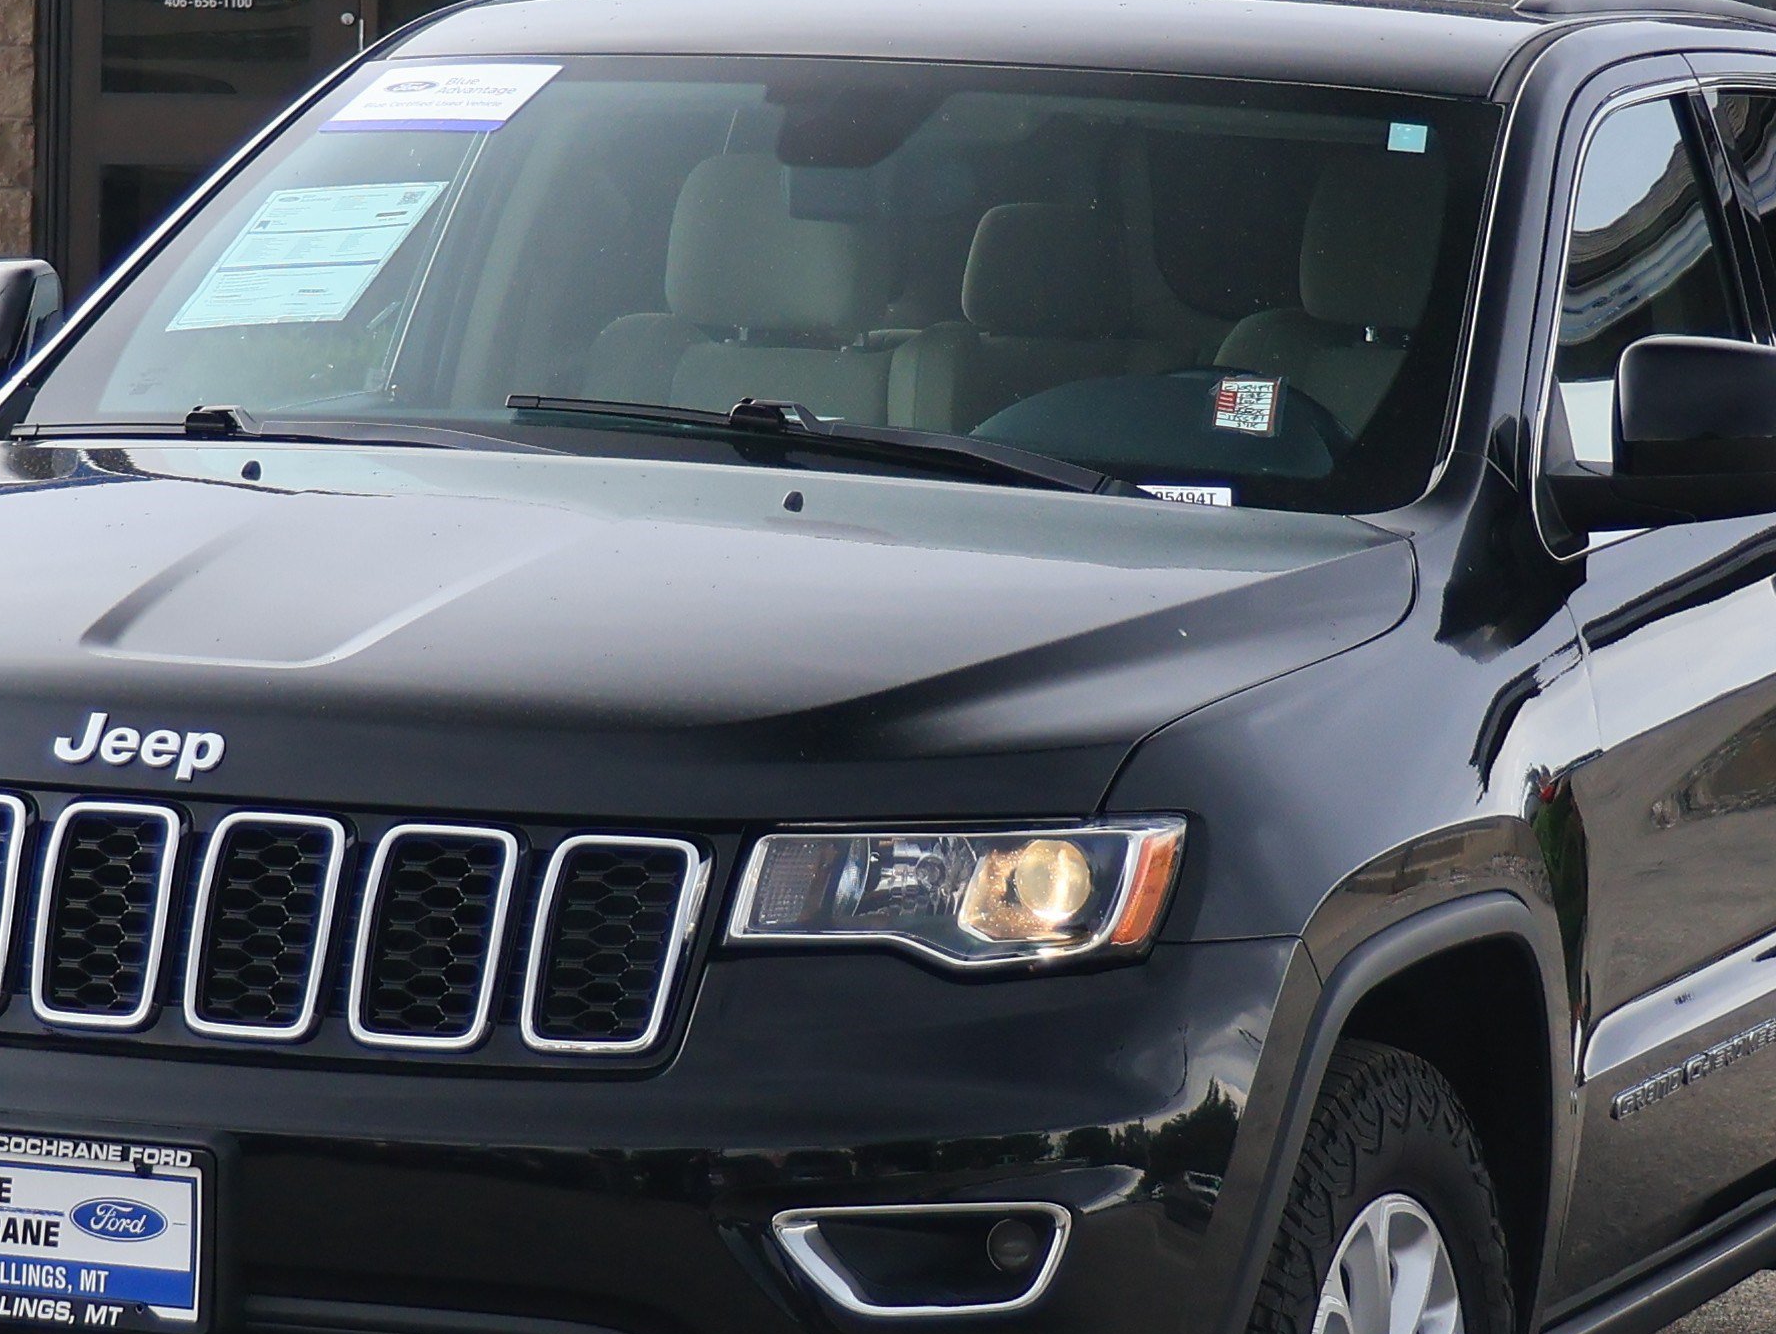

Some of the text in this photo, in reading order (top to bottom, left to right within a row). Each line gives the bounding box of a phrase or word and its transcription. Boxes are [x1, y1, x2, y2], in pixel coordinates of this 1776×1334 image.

[435, 85, 518, 96] Advantage
[445, 77, 480, 86] Blue
[53, 711, 226, 782] Jeep
[128, 1146, 193, 1168] FORD
[89, 1201, 146, 1234] Ford
[80, 1269, 110, 1294] MT
[84, 1304, 124, 1327] MT
